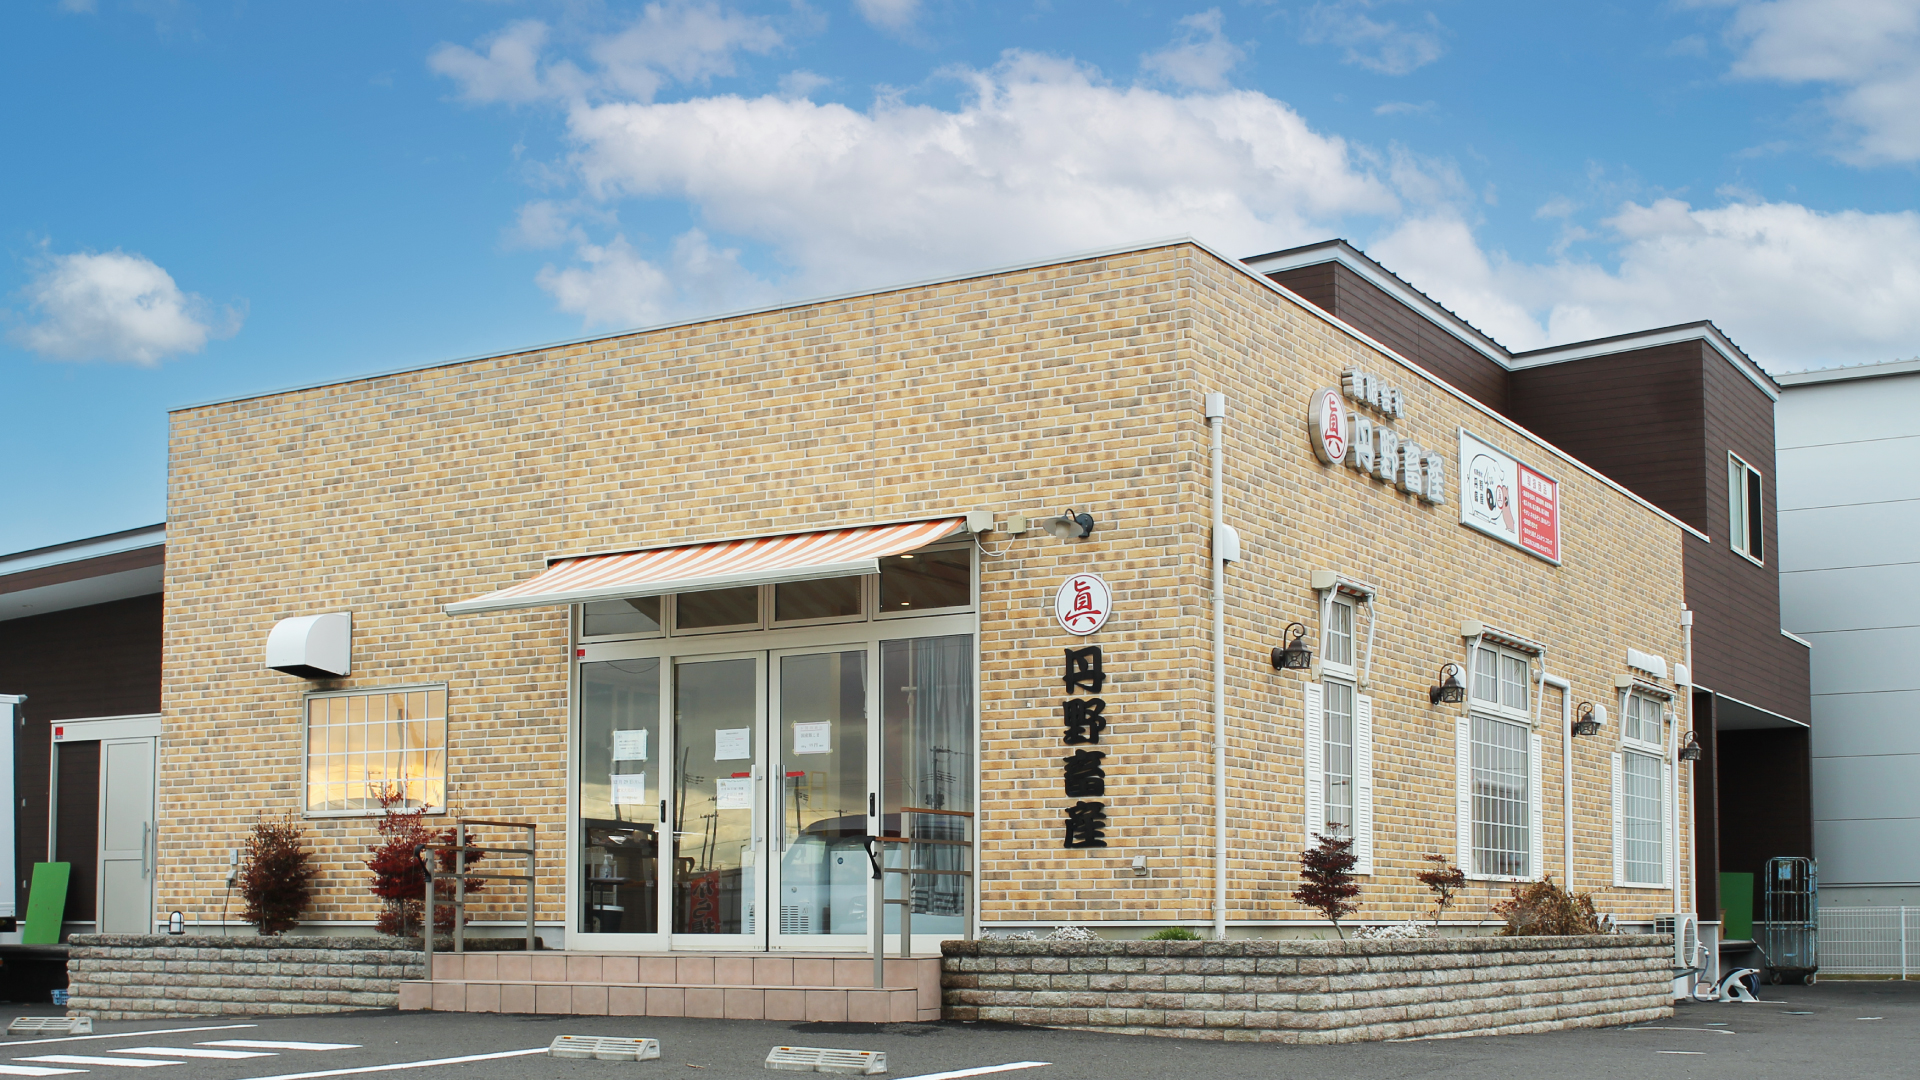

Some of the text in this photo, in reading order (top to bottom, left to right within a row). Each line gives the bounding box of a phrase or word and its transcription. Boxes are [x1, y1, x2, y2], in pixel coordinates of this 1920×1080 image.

[1353, 412, 1445, 504] 丹野畜産
[1062, 645, 1108, 849] 丹野畜産
